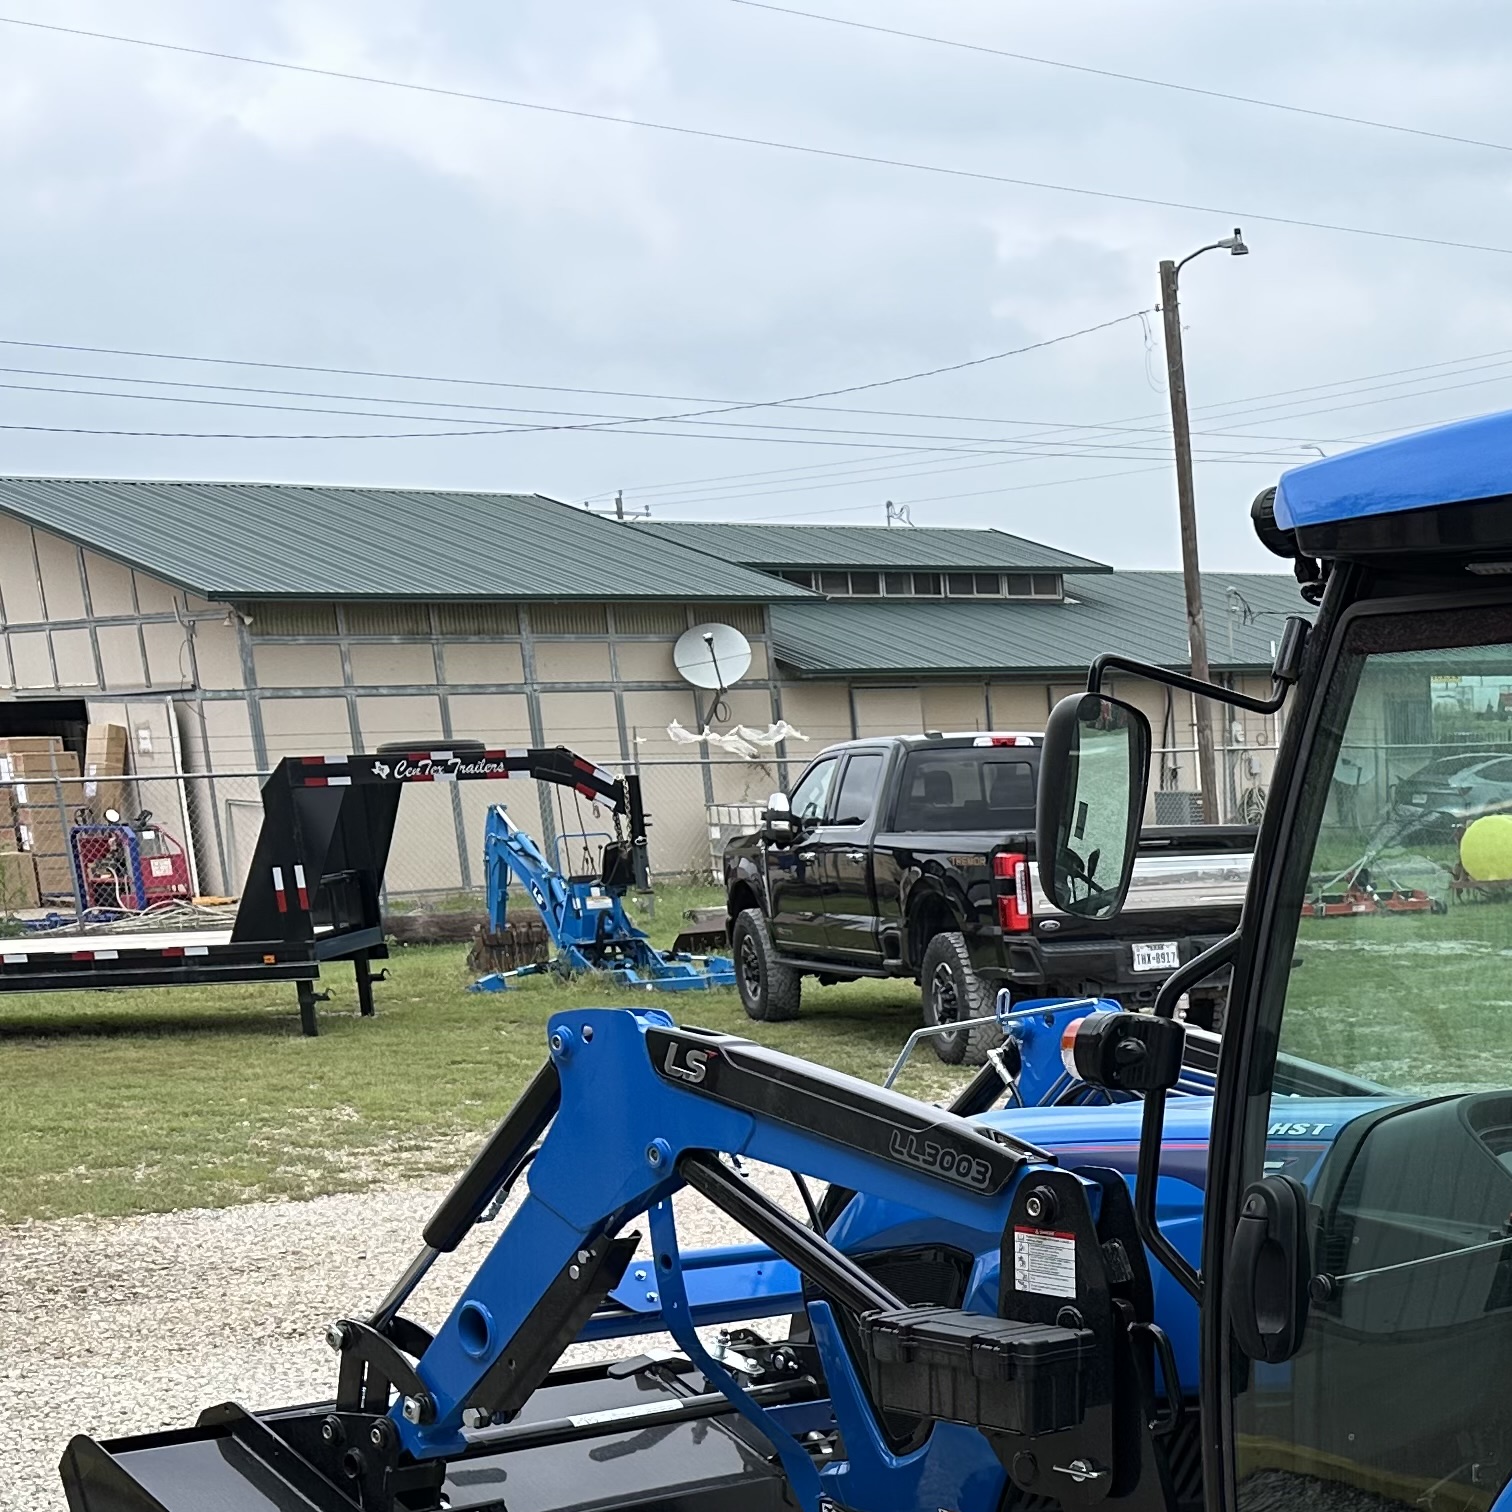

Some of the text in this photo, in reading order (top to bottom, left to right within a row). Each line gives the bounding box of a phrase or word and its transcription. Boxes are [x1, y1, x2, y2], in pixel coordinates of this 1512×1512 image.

[394, 759, 445, 779] CenTex
[447, 757, 505, 780] Trailers
[664, 1041, 709, 1083] LS
[1267, 1122, 1334, 1136] HST
[889, 1129, 993, 1189] LL3003
